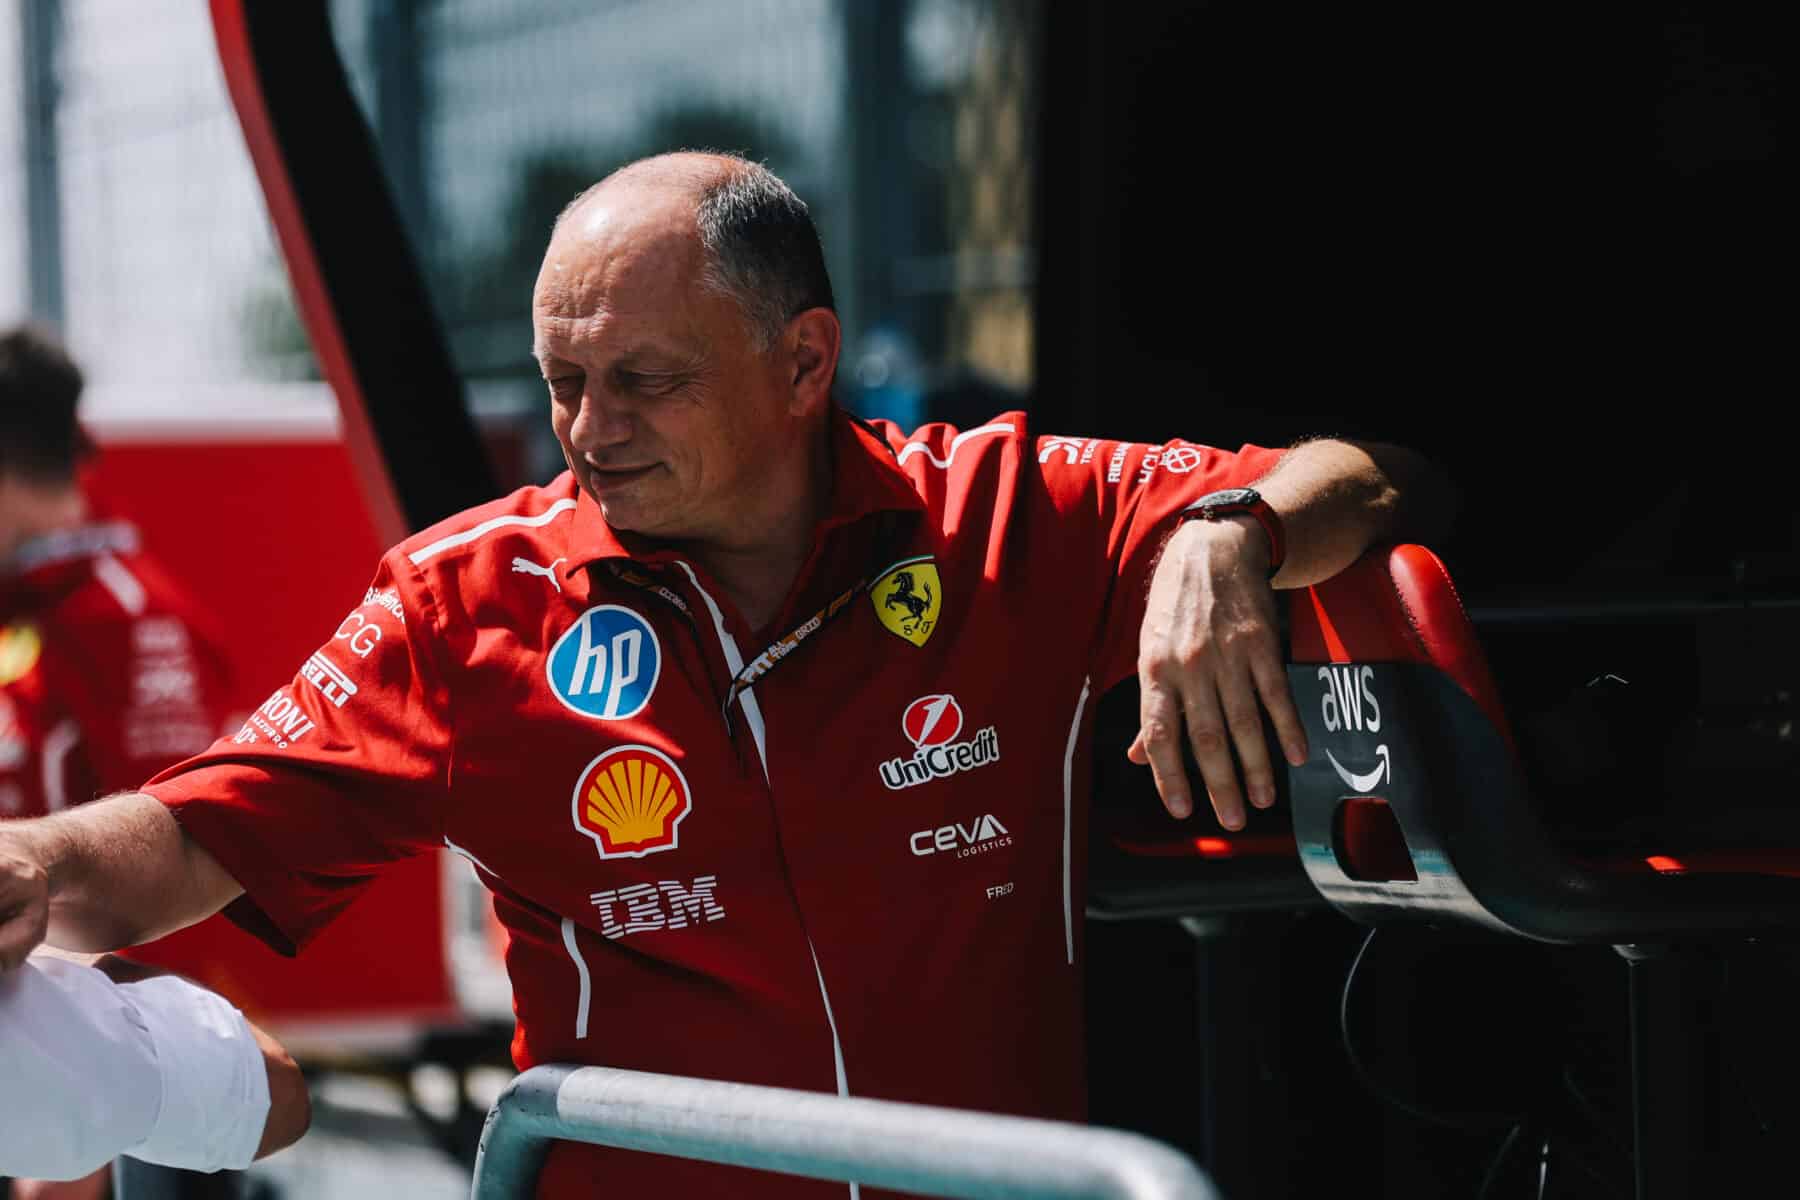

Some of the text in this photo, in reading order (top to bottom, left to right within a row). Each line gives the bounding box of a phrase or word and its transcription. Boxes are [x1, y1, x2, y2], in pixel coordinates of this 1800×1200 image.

[567, 611, 643, 719] hp
[1317, 665, 1381, 733] aws
[880, 727, 999, 789] UniCredit
[957, 837, 1013, 858] LOGISTICS
[589, 875, 726, 940] IBM
